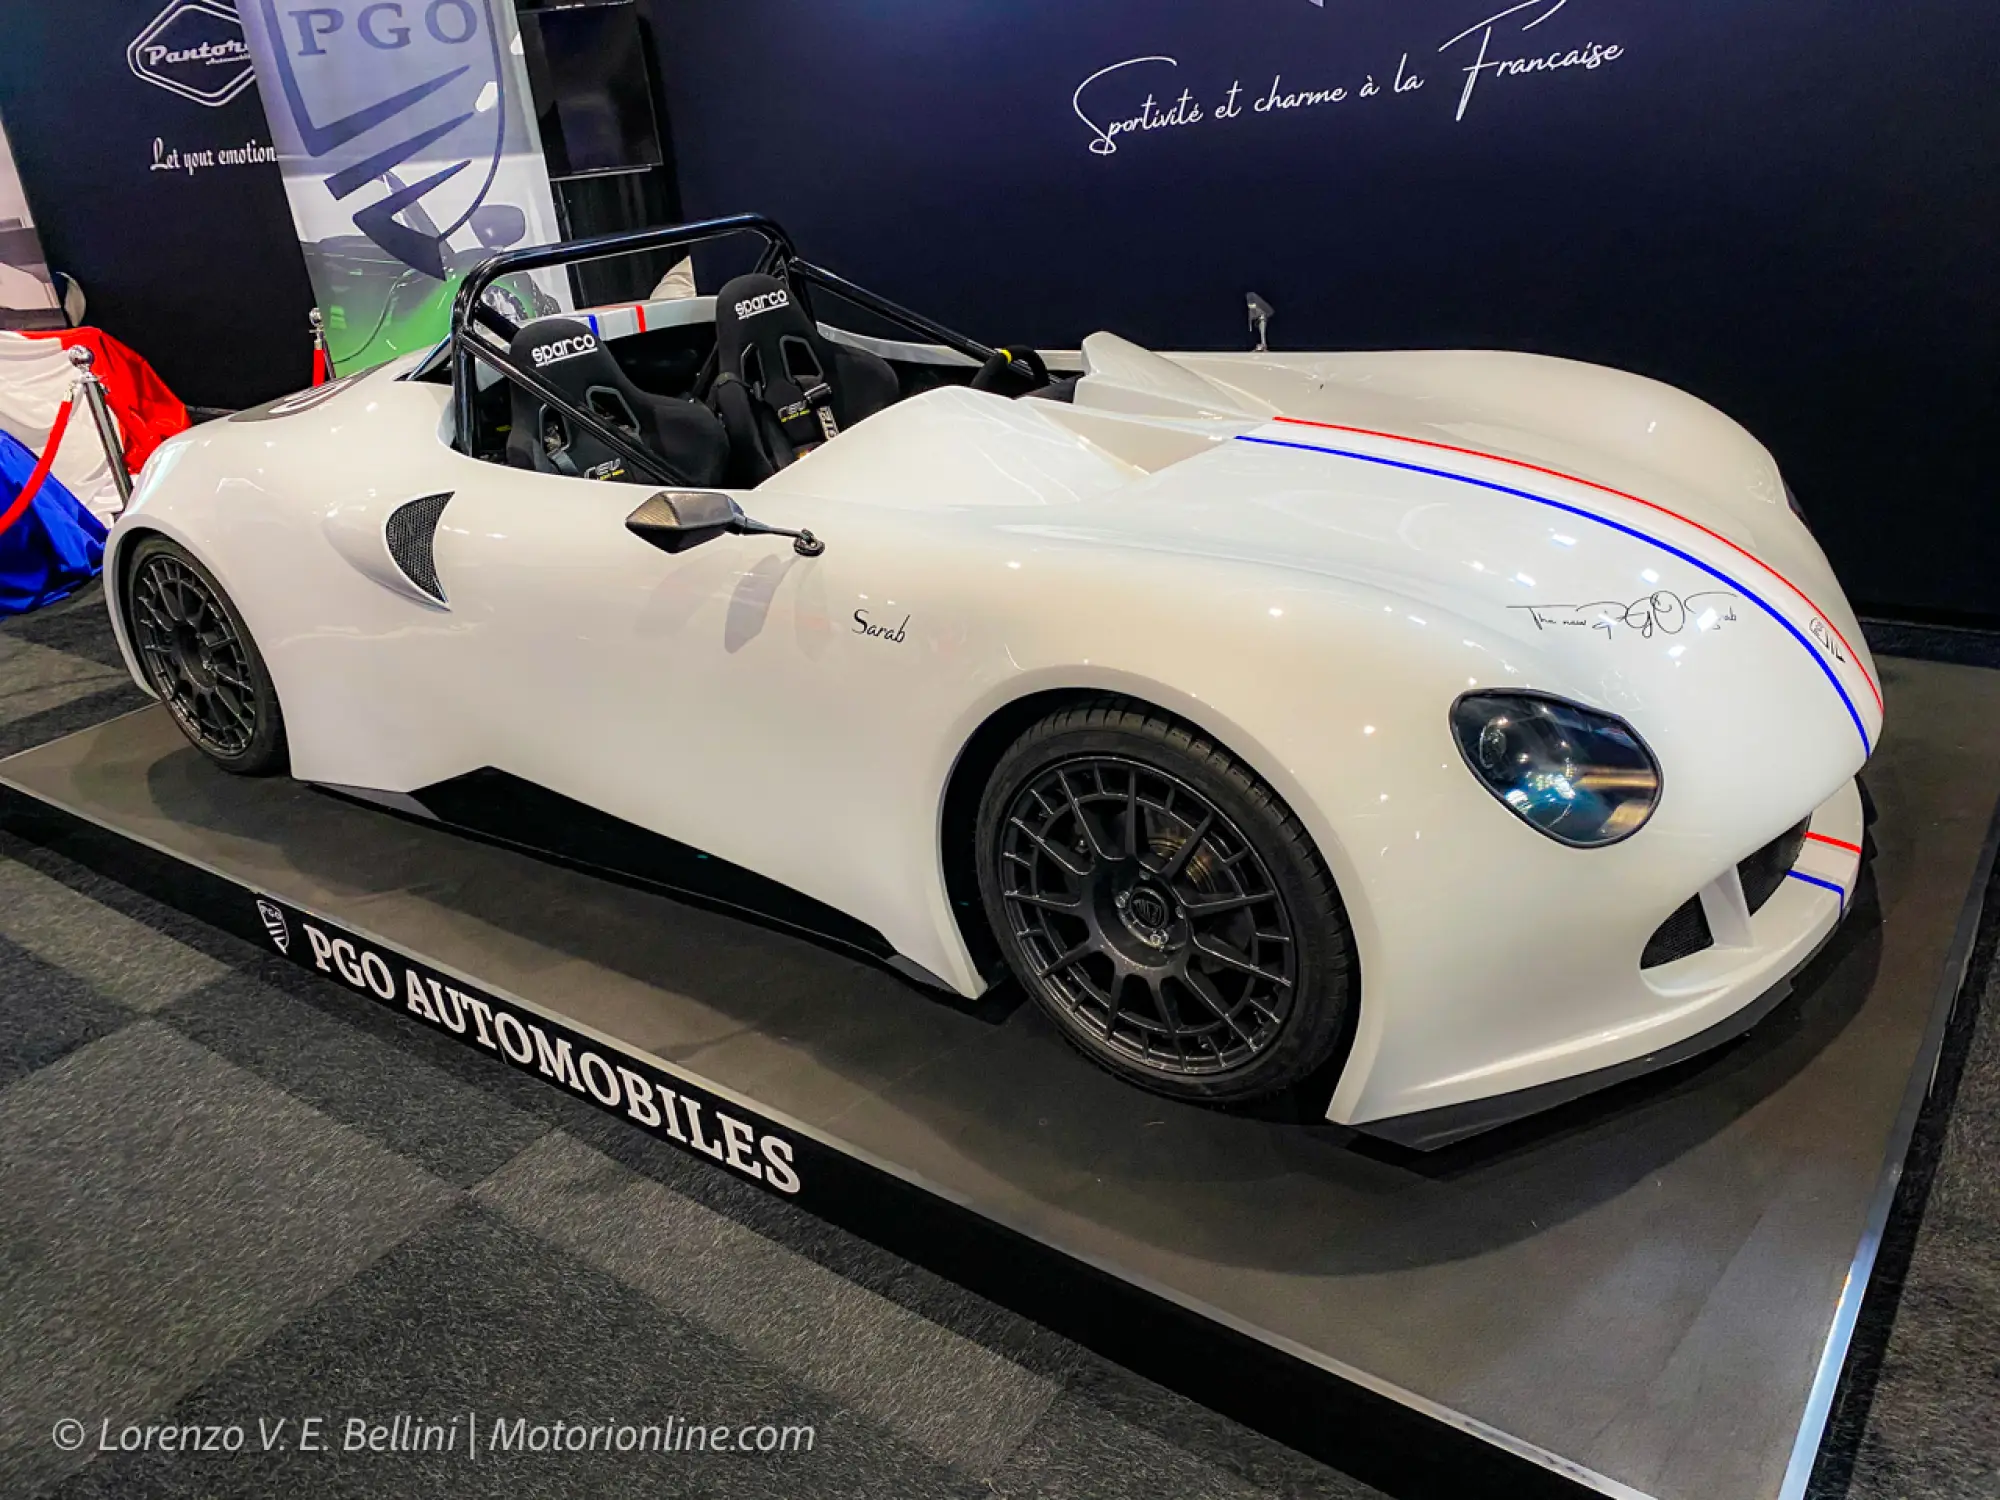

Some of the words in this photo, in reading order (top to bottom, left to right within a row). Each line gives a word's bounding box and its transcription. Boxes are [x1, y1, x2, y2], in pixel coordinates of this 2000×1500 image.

[288, 0, 478, 56] PGO
[1072, 55, 1204, 156] Sportivité
[1215, 80, 1242, 118] et
[1254, 74, 1348, 113] charme
[1360, 74, 1380, 98] à
[1393, 52, 1425, 93] la
[1437, 0, 1625, 122] Française
[150, 136, 181, 171] Let
[183, 149, 215, 176] your
[735, 289, 789, 320] sparco
[532, 333, 598, 367] sparco
[851, 608, 911, 643] Sarab
[302, 923, 396, 1000] PGO
[405, 969, 801, 1194] AUTOMOBILES
